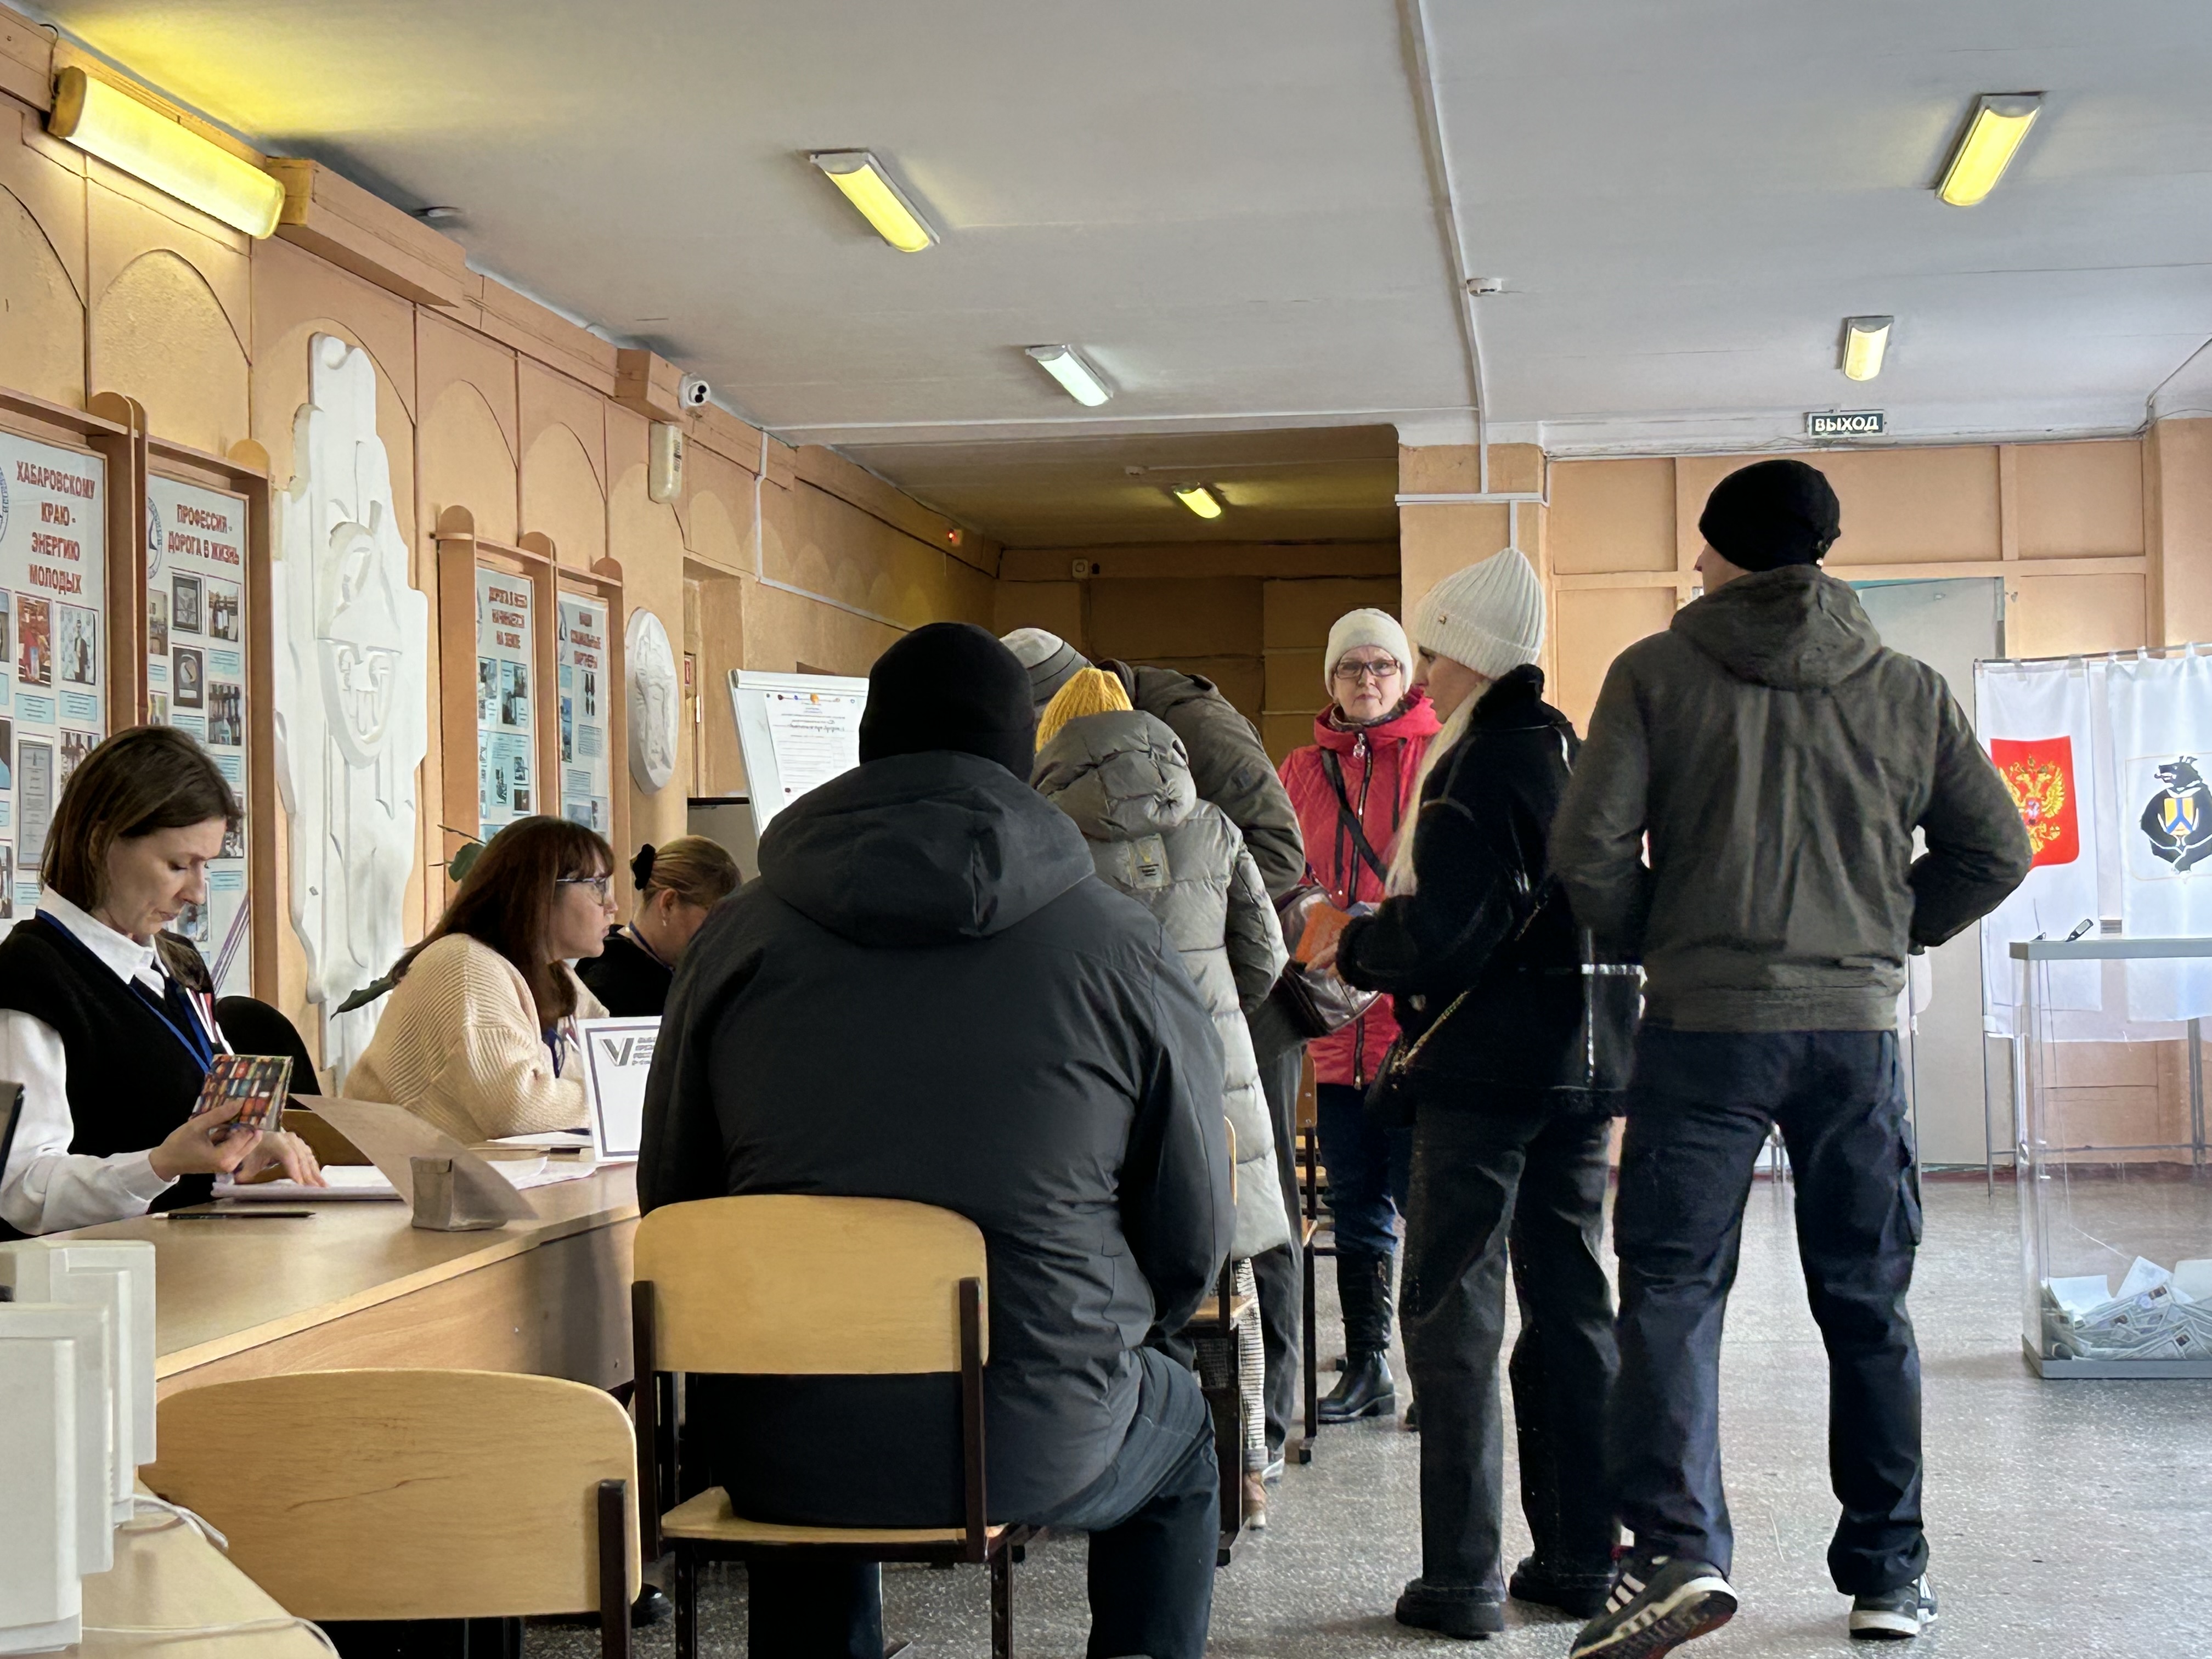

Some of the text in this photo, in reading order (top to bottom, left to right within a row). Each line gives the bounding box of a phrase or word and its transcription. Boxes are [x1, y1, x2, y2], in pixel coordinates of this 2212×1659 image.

[1815, 416, 1879, 432] ВЫХОД
[16, 460, 95, 500] ХАБАРОВСКОМУ
[41, 501, 70, 526] КРАЮ
[32, 532, 80, 561] ЭНЕРГИЮ
[168, 531, 202, 556] ДОРОГА
[204, 539, 209, 558] В
[29, 563, 82, 595] МОЛОДЫХ
